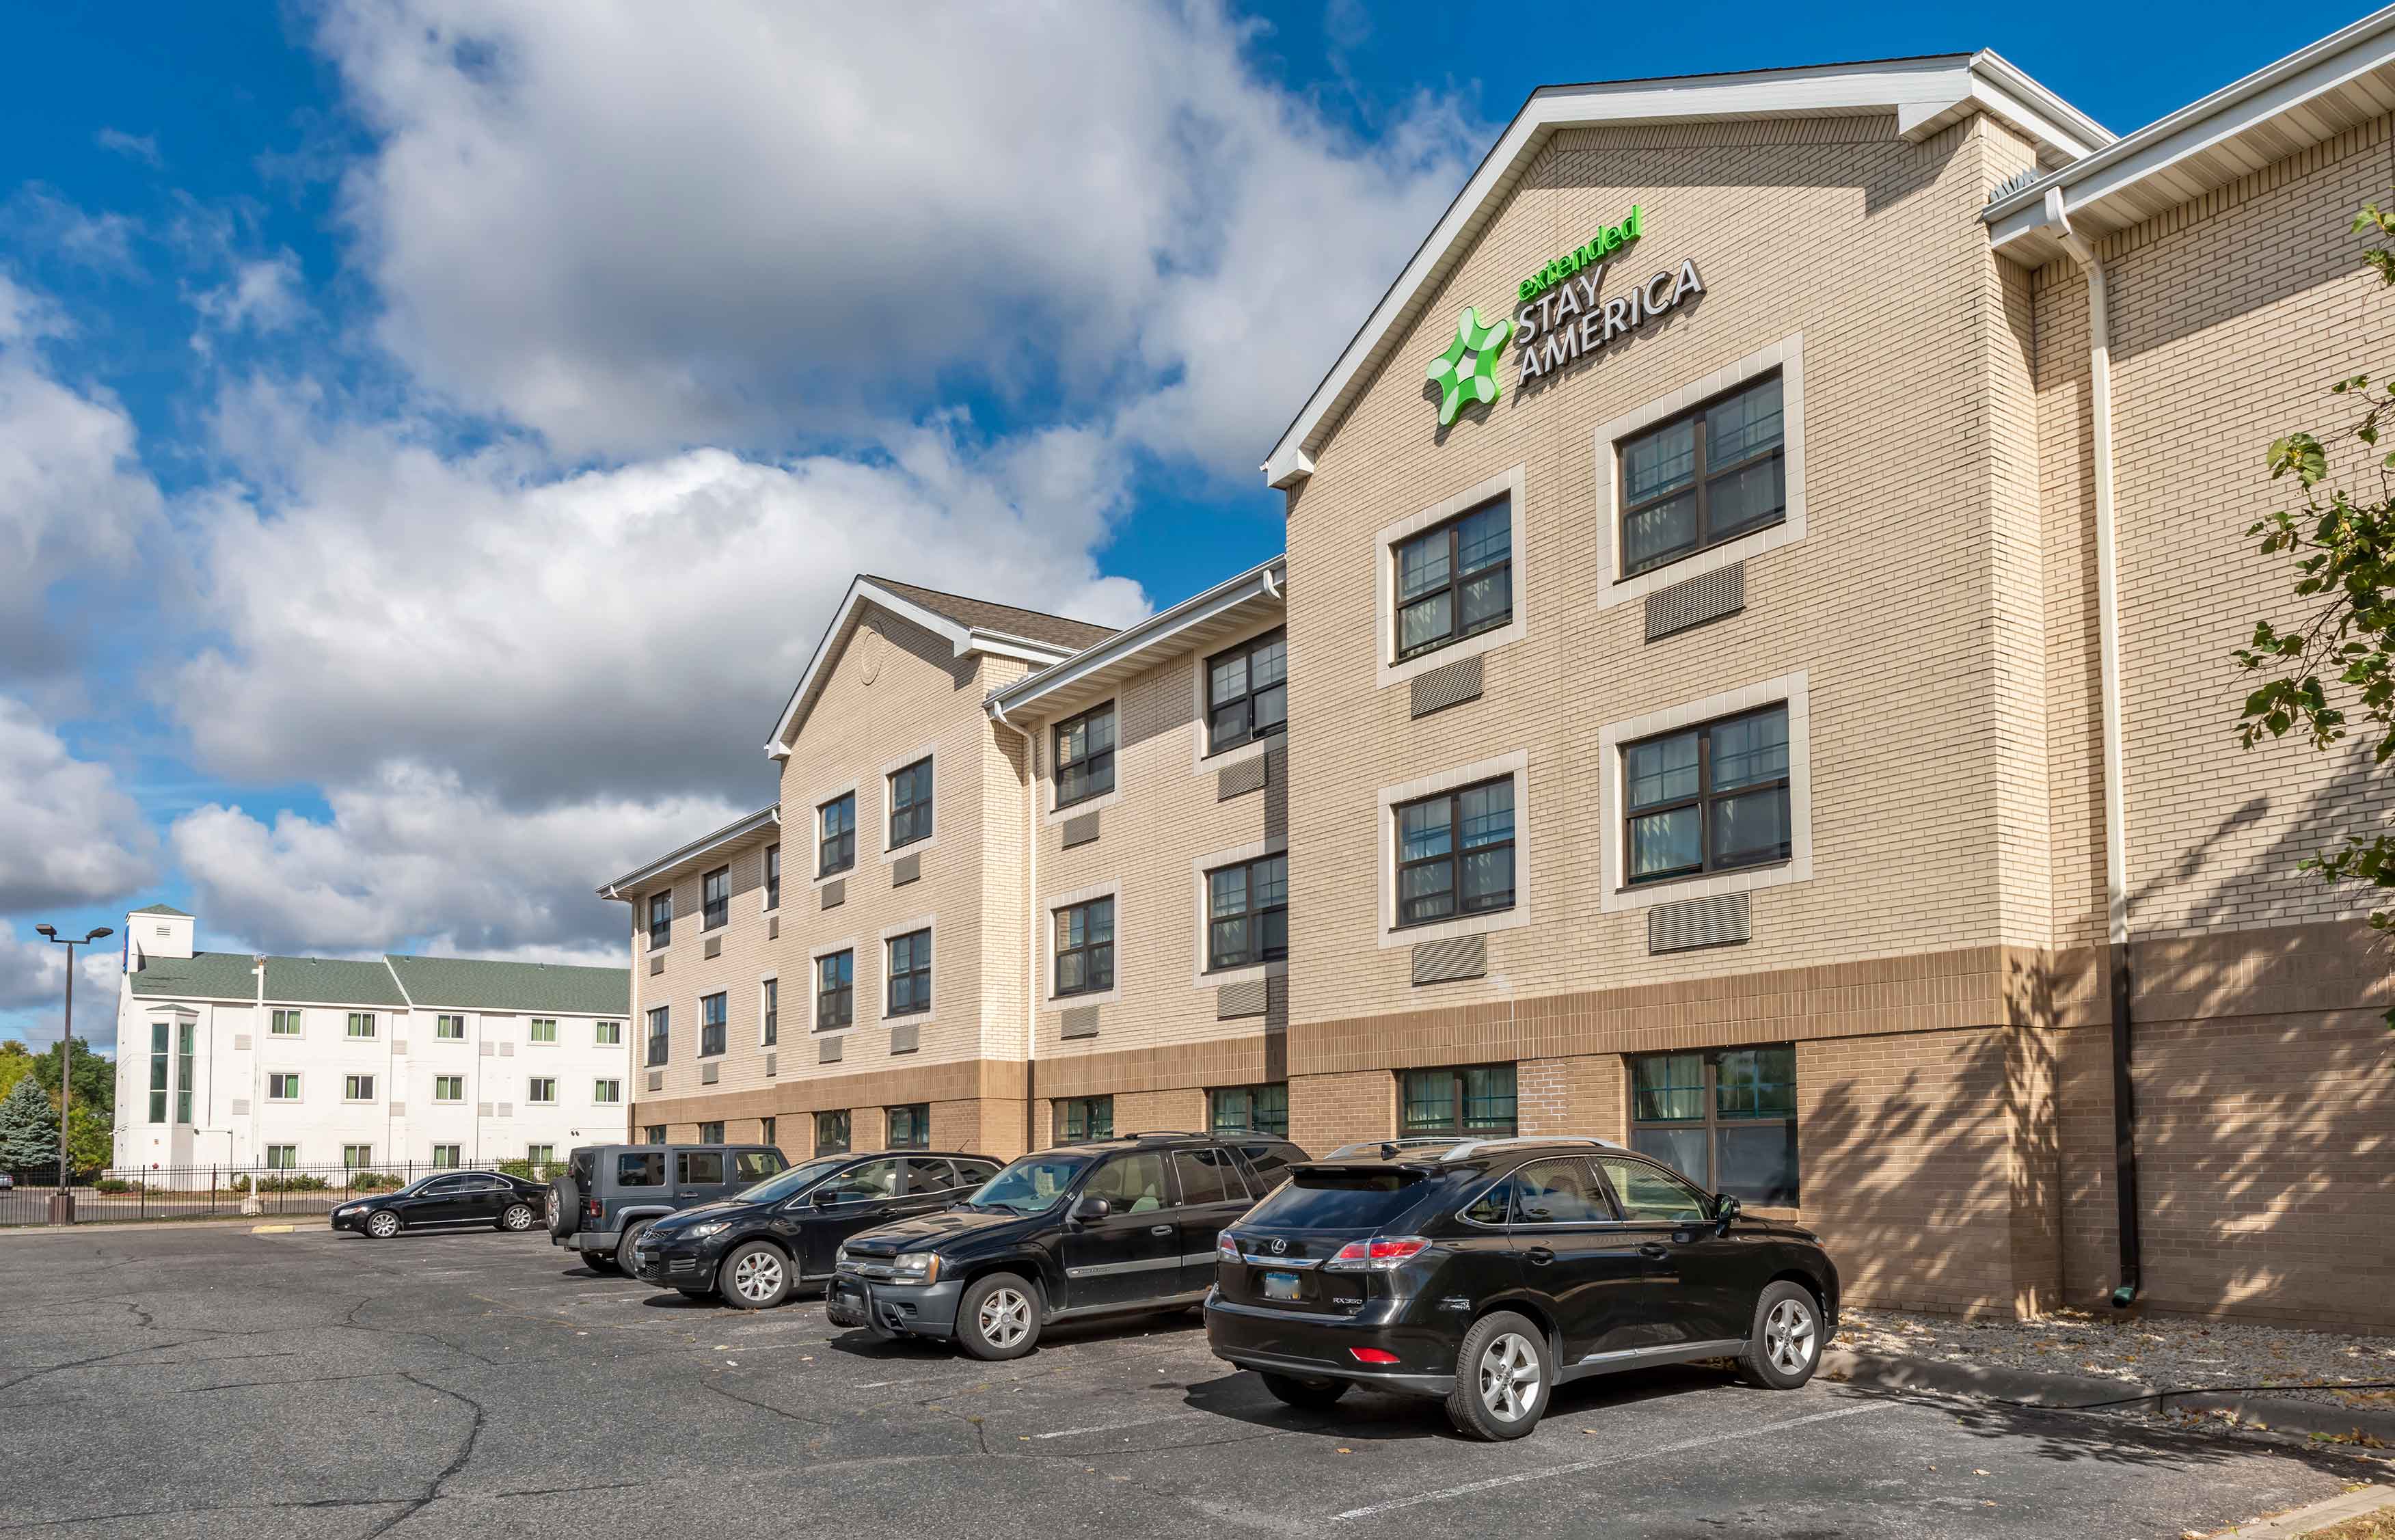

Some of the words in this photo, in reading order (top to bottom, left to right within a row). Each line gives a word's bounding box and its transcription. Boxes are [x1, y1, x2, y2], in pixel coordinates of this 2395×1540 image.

[1519, 204, 1642, 301] extended
[1518, 258, 1707, 388] AMERICA
[1519, 262, 1608, 345] STAY
